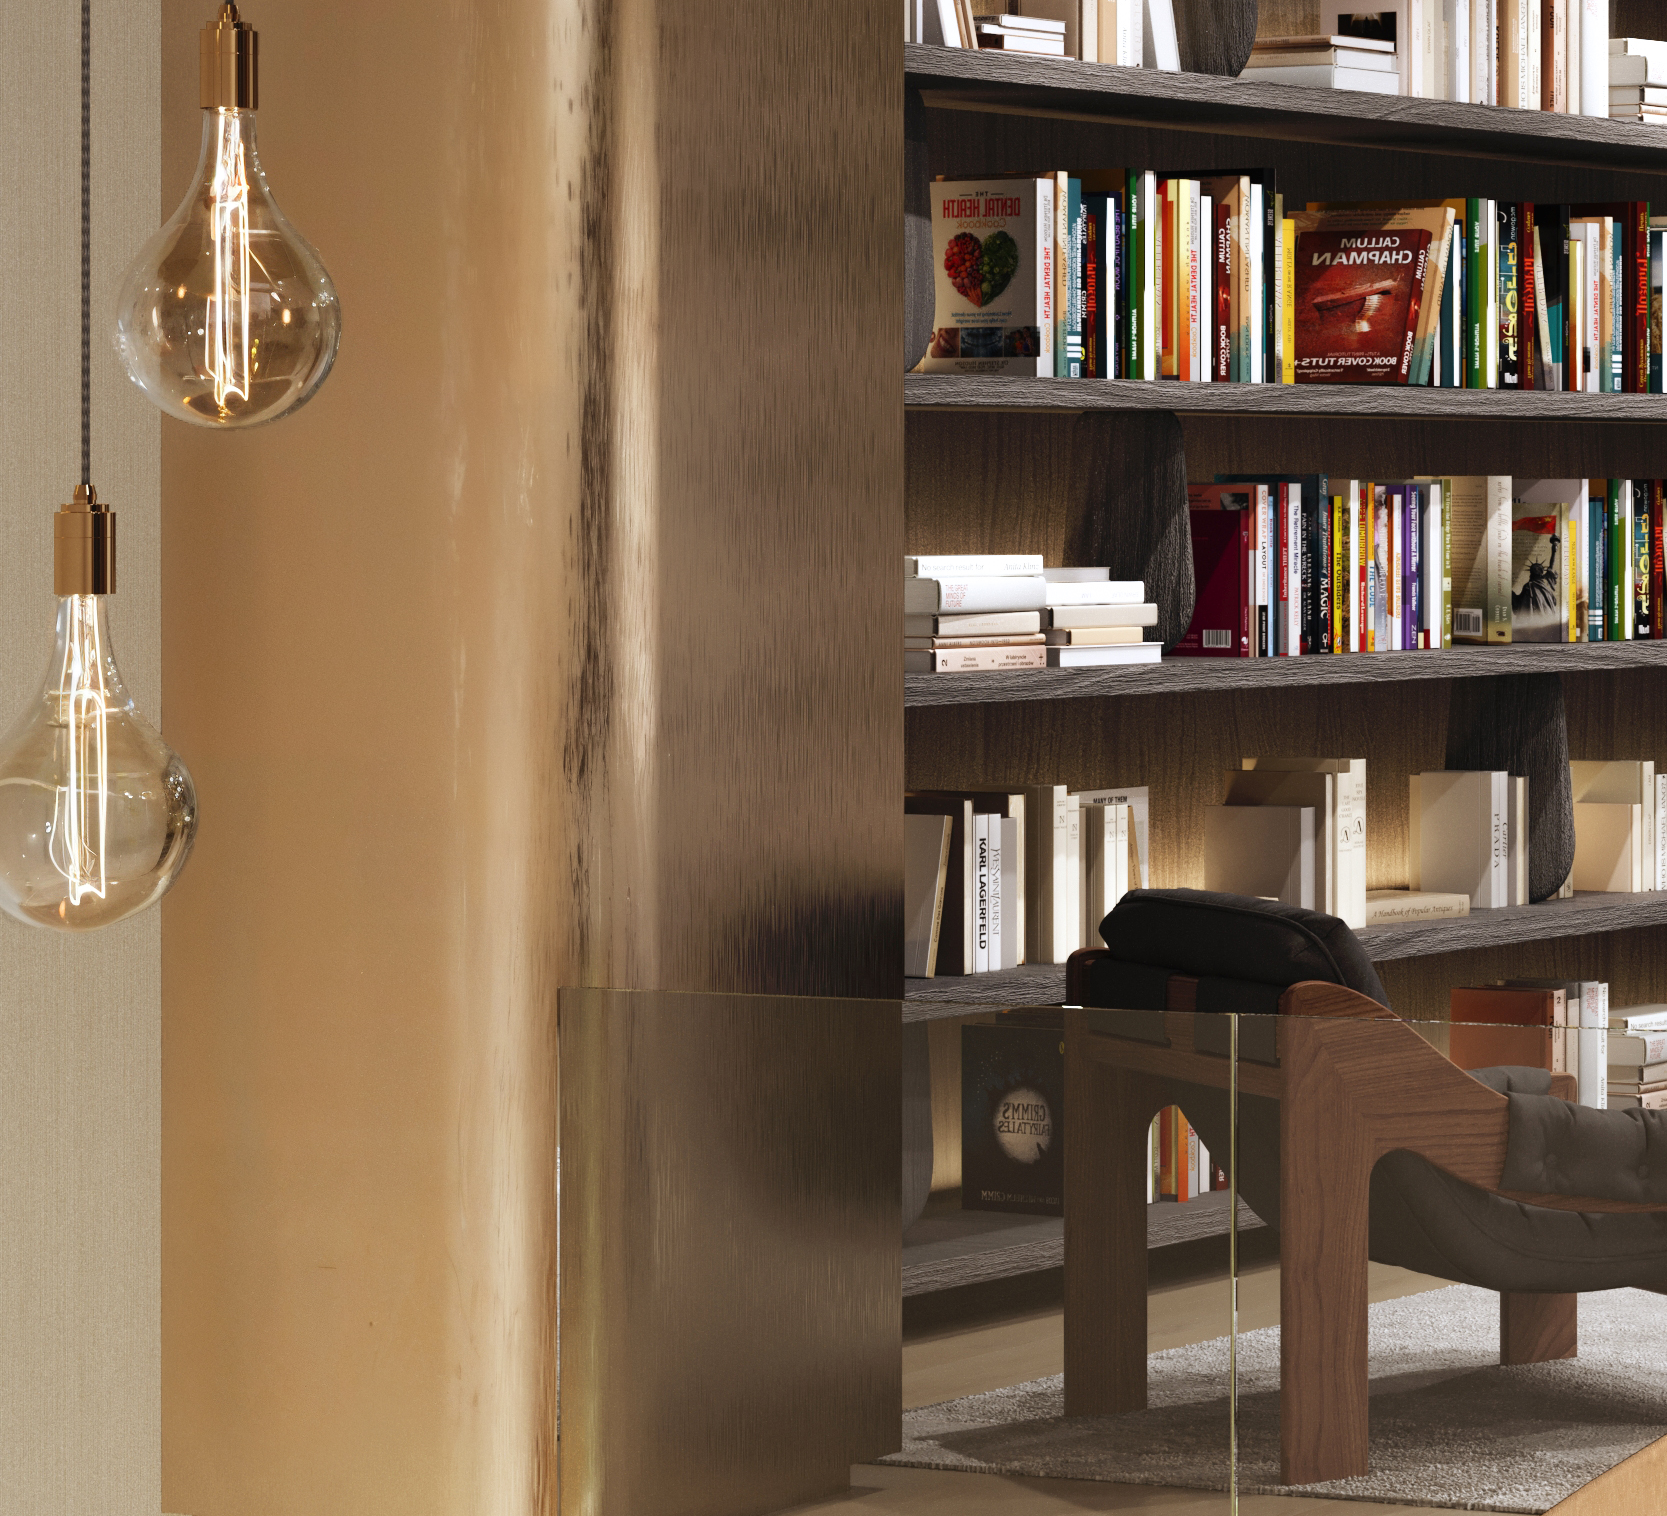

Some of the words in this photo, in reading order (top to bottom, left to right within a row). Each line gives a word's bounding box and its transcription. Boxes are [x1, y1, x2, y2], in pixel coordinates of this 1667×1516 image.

[1301, 530, 1307, 539] IN
[921, 563, 932, 571] No
[932, 563, 955, 571] search
[955, 563, 974, 571] result
[975, 563, 985, 571] for
[945, 584, 955, 592] THE
[955, 584, 969, 592] GREAT
[945, 592, 960, 600] MINDS
[960, 592, 967, 600] OF
[1320, 577, 1329, 619] MAGIC
[945, 600, 962, 608] FUTURE
[1115, 795, 1128, 803] THEM
[978, 837, 987, 872] KARL
[978, 874, 987, 950] LAGERFELD
[1378, 908, 1404, 918] Handbook
[1404, 907, 1411, 918] of
[1411, 906, 1431, 917] Popular
[1431, 905, 1454, 915] Antiques
[1638, 1021, 1654, 1029] search
